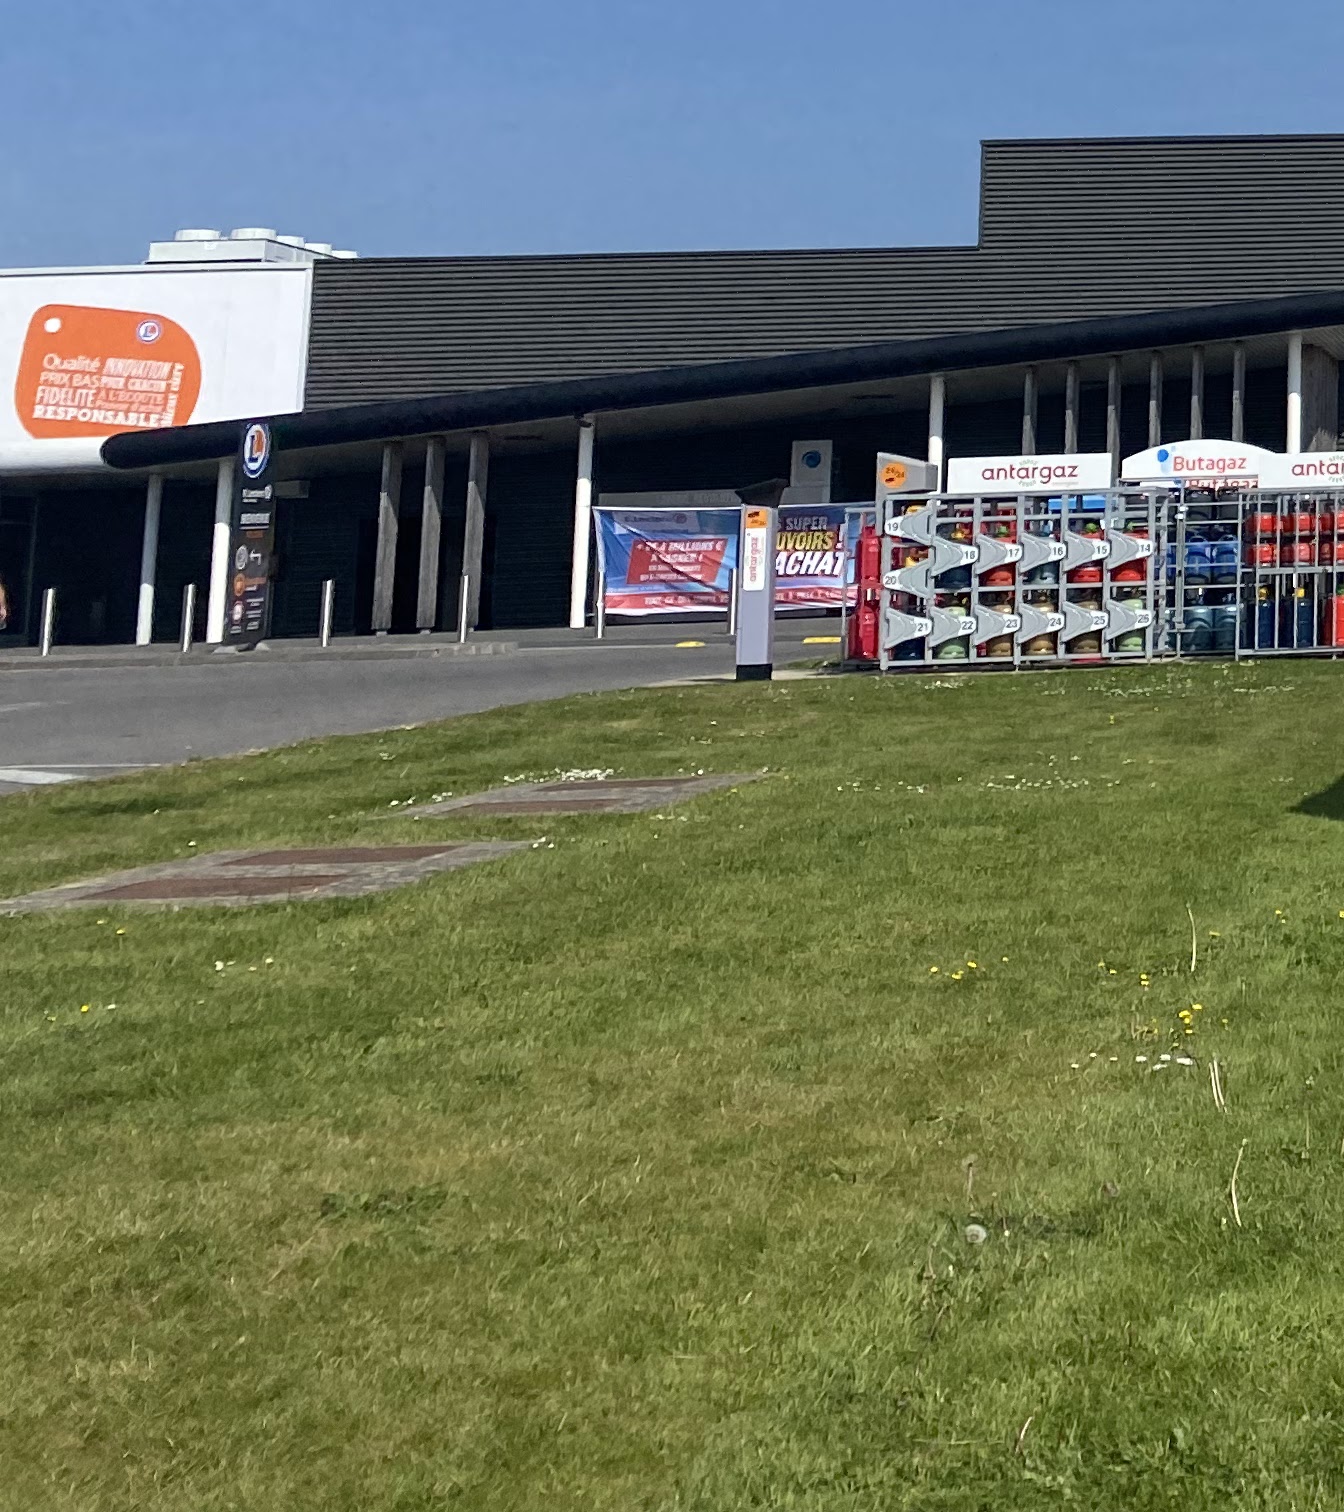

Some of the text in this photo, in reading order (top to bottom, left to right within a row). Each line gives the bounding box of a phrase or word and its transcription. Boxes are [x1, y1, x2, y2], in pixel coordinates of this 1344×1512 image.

[32, 405, 161, 426] RESPONSABLE
[1173, 455, 1247, 474] Butagaz
[982, 464, 1079, 484] antargaz
[785, 516, 828, 531] SUPER
[887, 522, 899, 531] 19
[776, 531, 834, 551] UVOIRS
[1008, 548, 1020, 558] 17
[1140, 543, 1151, 553] 14
[776, 551, 845, 576] ACHAT
[884, 575, 897, 585] 20
[961, 620, 974, 630] 22
[1005, 619, 1018, 628] 23
[1049, 617, 1062, 626] 24
[1093, 615, 1106, 625] 25
[917, 622, 928, 632] 21
